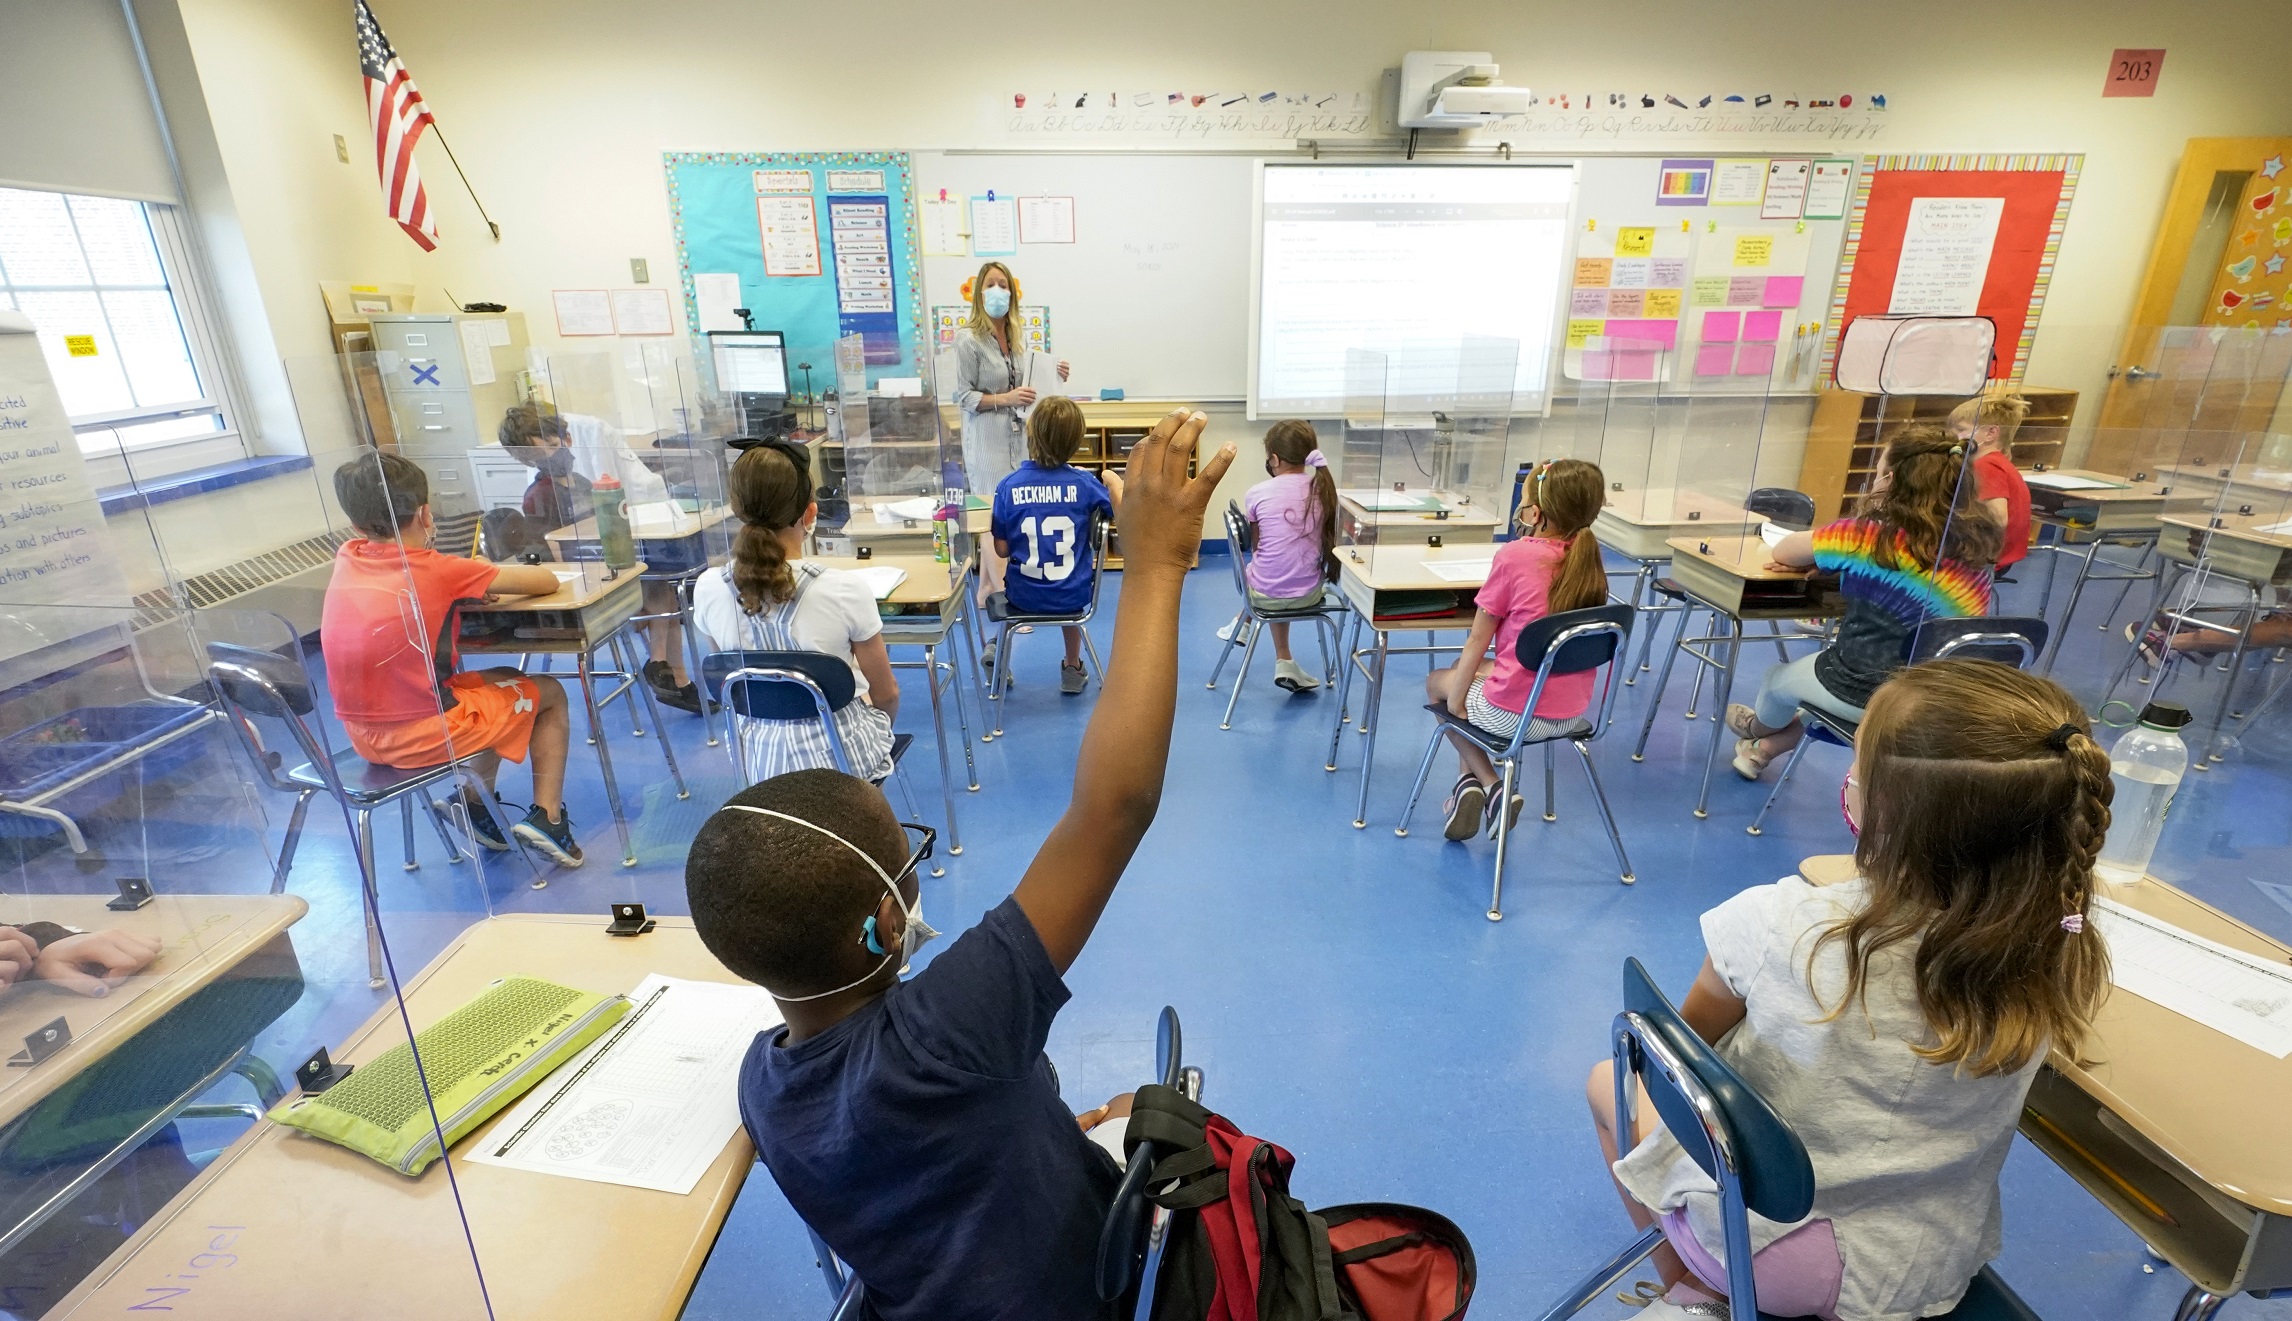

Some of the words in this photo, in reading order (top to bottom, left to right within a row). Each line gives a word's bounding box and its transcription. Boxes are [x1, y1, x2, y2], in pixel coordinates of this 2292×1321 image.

[2116, 61, 2152, 81] 203
[1009, 116, 1036, 132] Aa
[1042, 115, 1066, 132] Bb
[1071, 115, 1094, 132] Cc
[1099, 114, 1125, 132] Dd
[1132, 115, 1153, 132] Ee
[1161, 114, 1187, 138] Ff
[1190, 114, 1213, 138] Gg
[1217, 114, 1247, 132] Hh
[1252, 115, 1281, 132] Ii
[1284, 114, 1308, 138] Jj
[1310, 114, 1340, 132] Kk
[1341, 113, 1371, 133] Ll
[1483, 117, 1519, 133] Mm
[1520, 117, 1550, 133] Nn
[1553, 116, 1574, 132] Oo
[1576, 116, 1600, 137] Pp
[1602, 116, 1625, 138] Qq
[1628, 116, 1657, 132] Rr
[1658, 116, 1682, 132] Ss
[1685, 116, 1715, 132] Tt
[1717, 117, 1747, 132] Uu
[1748, 117, 1769, 132] Vv
[1769, 117, 1800, 132] Ww
[1802, 117, 1828, 132] Xx
[1829, 117, 1856, 138] Yy
[1857, 117, 1887, 138] Zz
[767, 176, 799, 185] Specials
[840, 176, 872, 186] Schedule
[70, 347, 95, 355] WINDOW
[26, 441, 61, 457] animal
[11, 473, 67, 489] resources
[1011, 486, 1061, 505] BECKHAM
[1064, 485, 1077, 502] JR
[11, 502, 63, 521] subtopics
[16, 534, 37, 549] and
[42, 526, 86, 546] pictures
[1020, 516, 1075, 581] 13
[35, 559, 57, 576] with
[61, 553, 91, 569] others
[542, 1013, 573, 1036] Nigel
[477, 1052, 521, 1076] Cerda
[127, 1226, 246, 1311] Nigel
